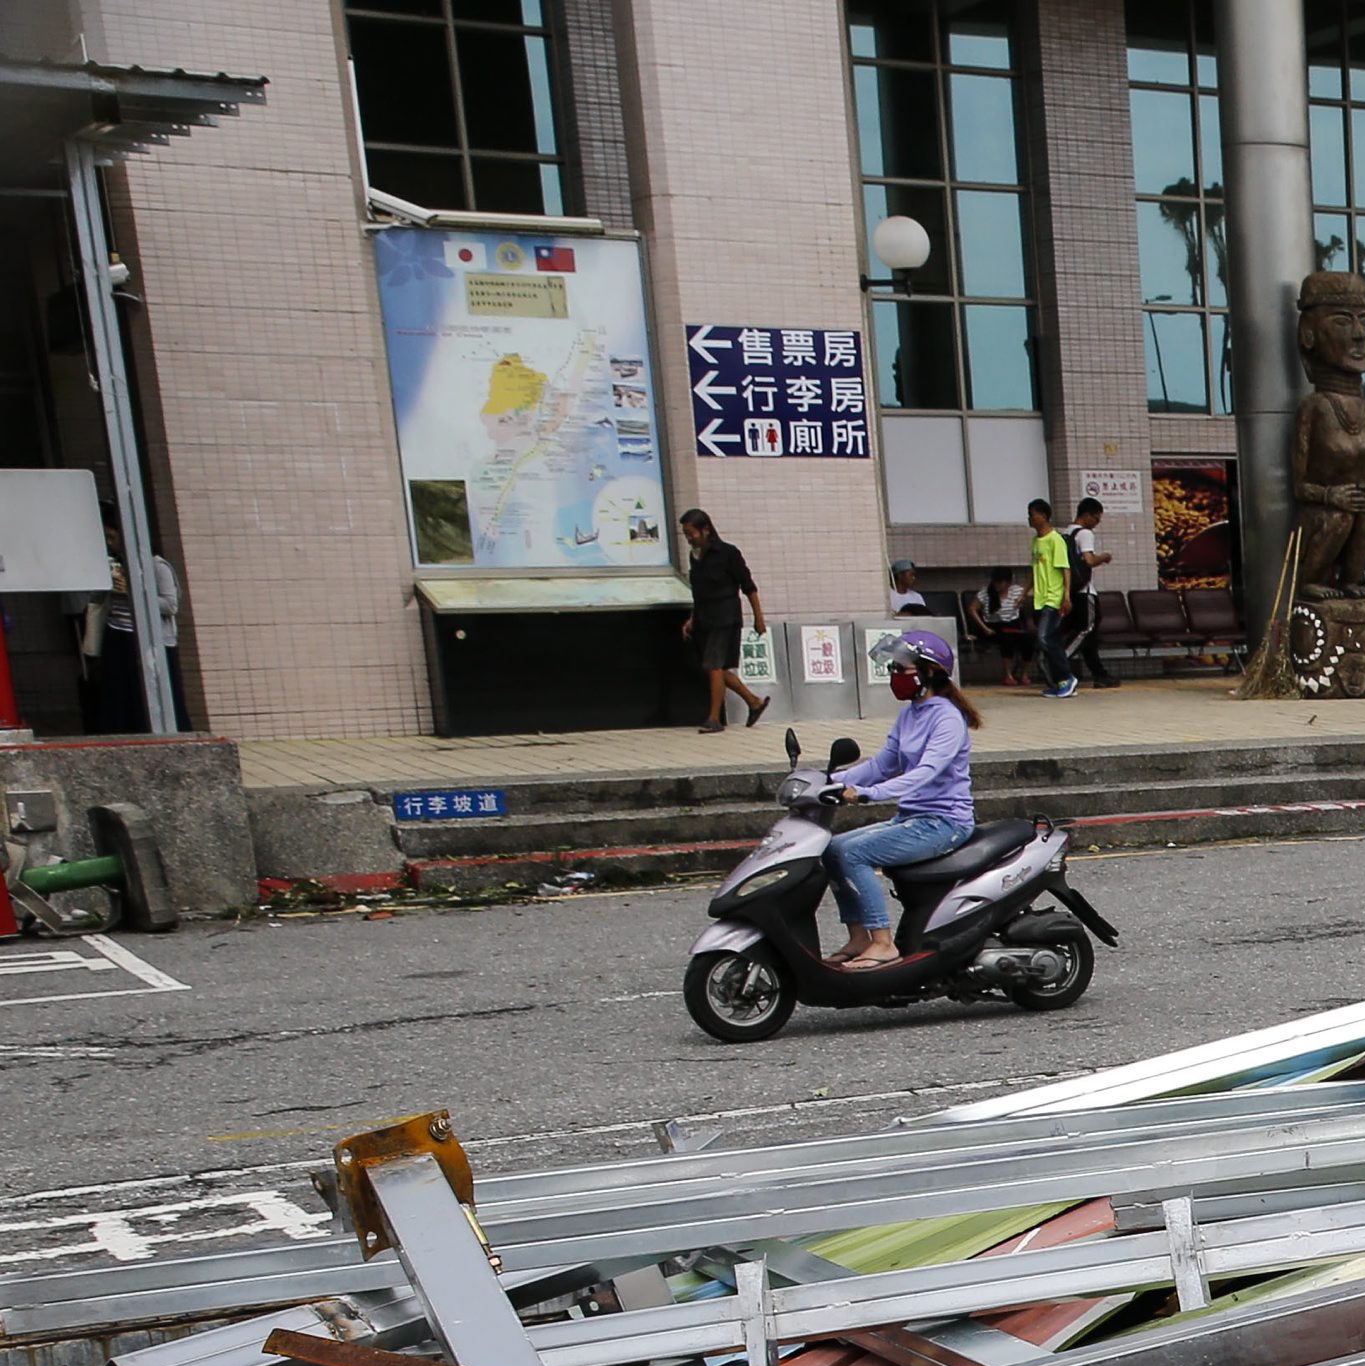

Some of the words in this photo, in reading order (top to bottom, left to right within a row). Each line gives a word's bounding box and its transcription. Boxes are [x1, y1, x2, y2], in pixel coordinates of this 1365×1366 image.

[737, 328, 857, 367] 售票房
[741, 375, 865, 413] 行李房
[789, 418, 866, 455] 廁所
[810, 643, 833, 658] 一般
[744, 661, 768, 677] 垃圾
[811, 660, 835, 675] 垃圾
[403, 792, 498, 816] 行李坡道
